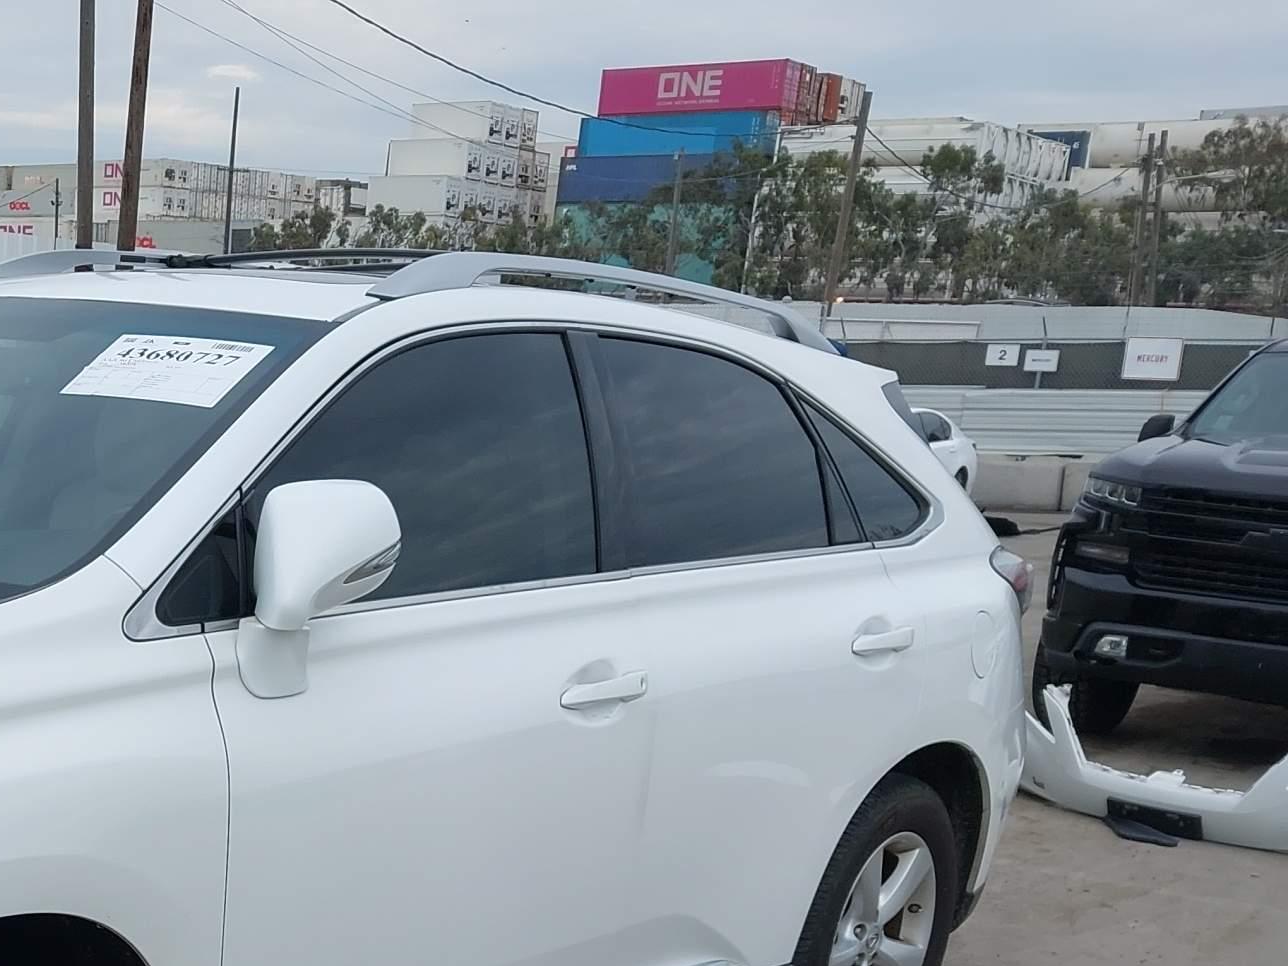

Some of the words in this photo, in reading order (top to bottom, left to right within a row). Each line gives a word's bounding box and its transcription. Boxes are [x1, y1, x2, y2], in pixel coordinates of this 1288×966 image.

[657, 69, 724, 98] ONE
[103, 163, 124, 178] ON
[9, 201, 30, 210] OOCL
[102, 191, 121, 206] ON
[136, 236, 156, 249] OCL
[117, 346, 241, 367] 43680727
[998, 349, 1007, 361] 2
[1136, 354, 1169, 363] MERCURY
